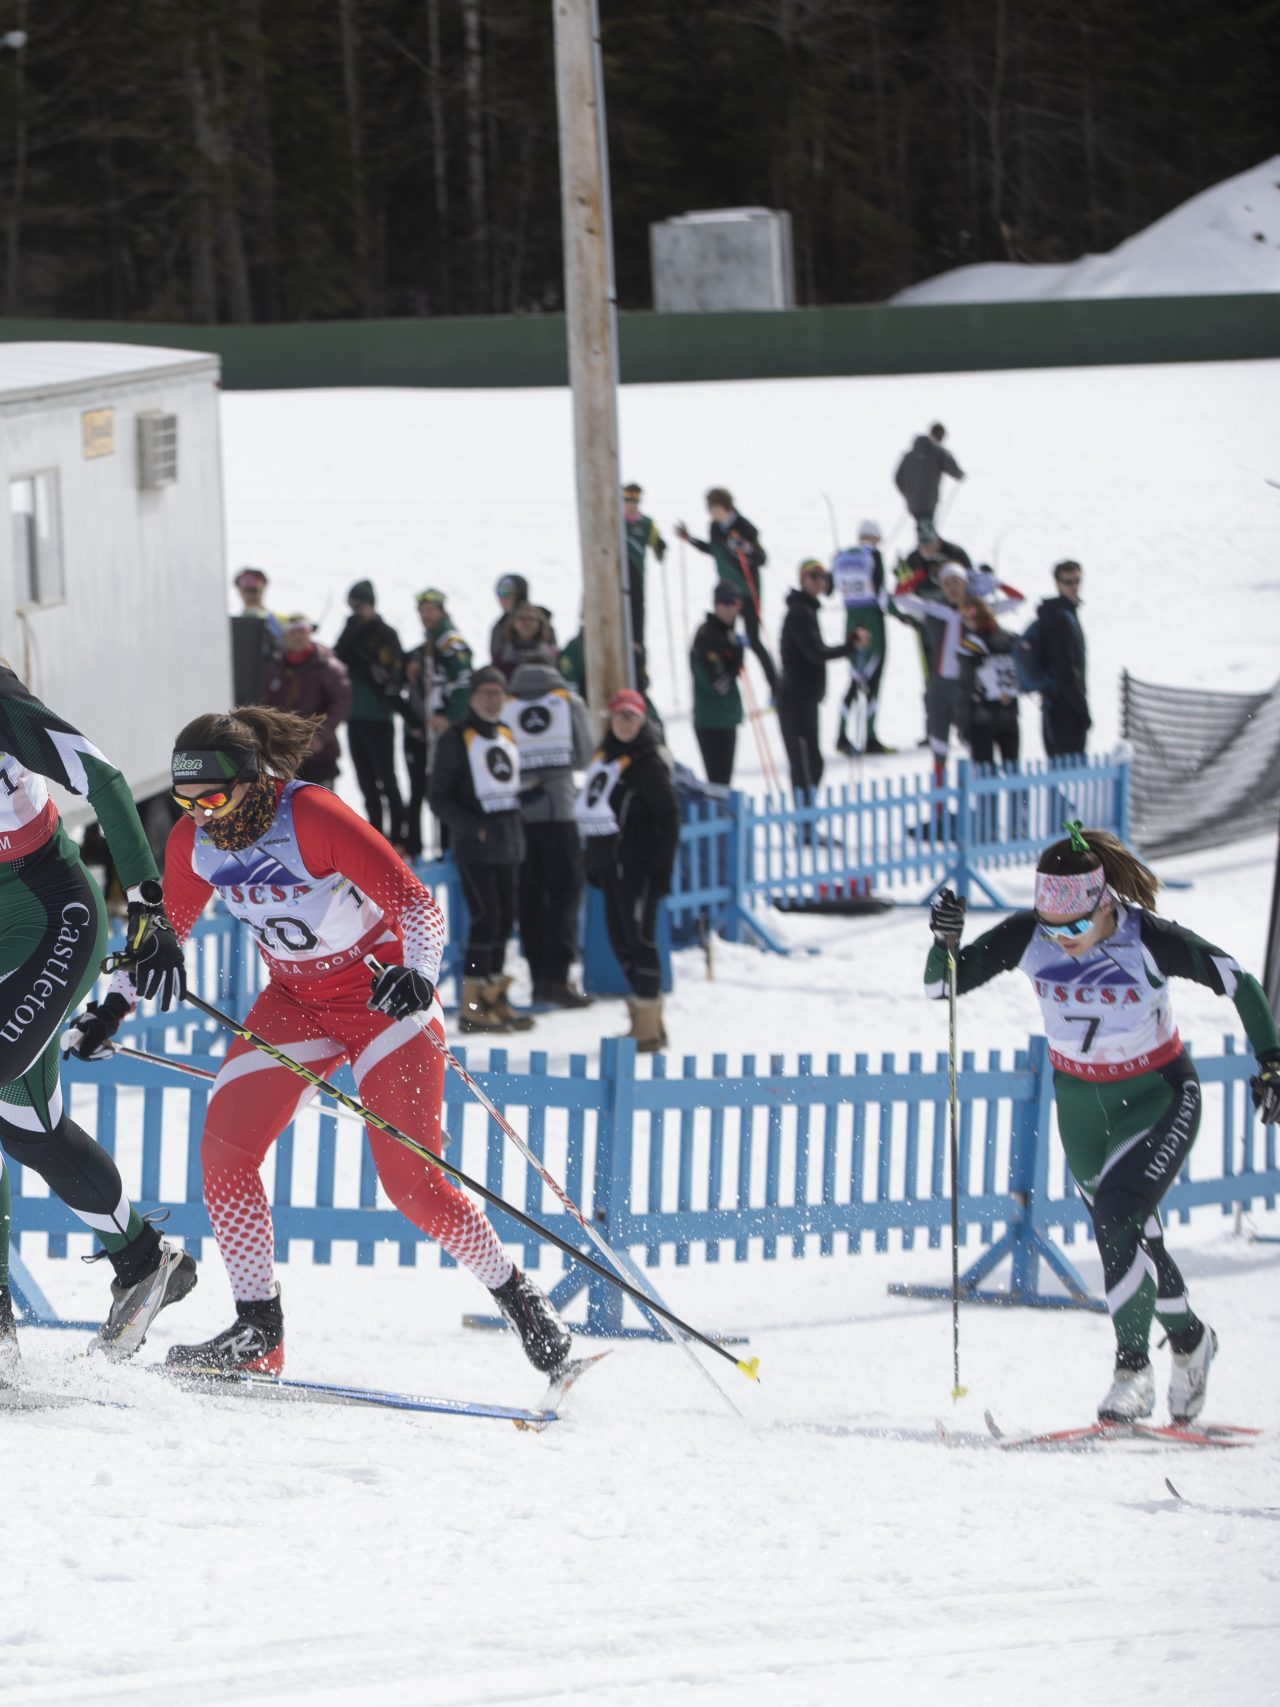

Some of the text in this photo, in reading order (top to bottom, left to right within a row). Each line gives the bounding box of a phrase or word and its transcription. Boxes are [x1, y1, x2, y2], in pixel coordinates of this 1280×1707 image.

[0, 768, 19, 796] 1
[1034, 978, 1142, 1004] USCSA
[1064, 1016, 1101, 1053] 7
[1144, 1080, 1200, 1180] Castleton
